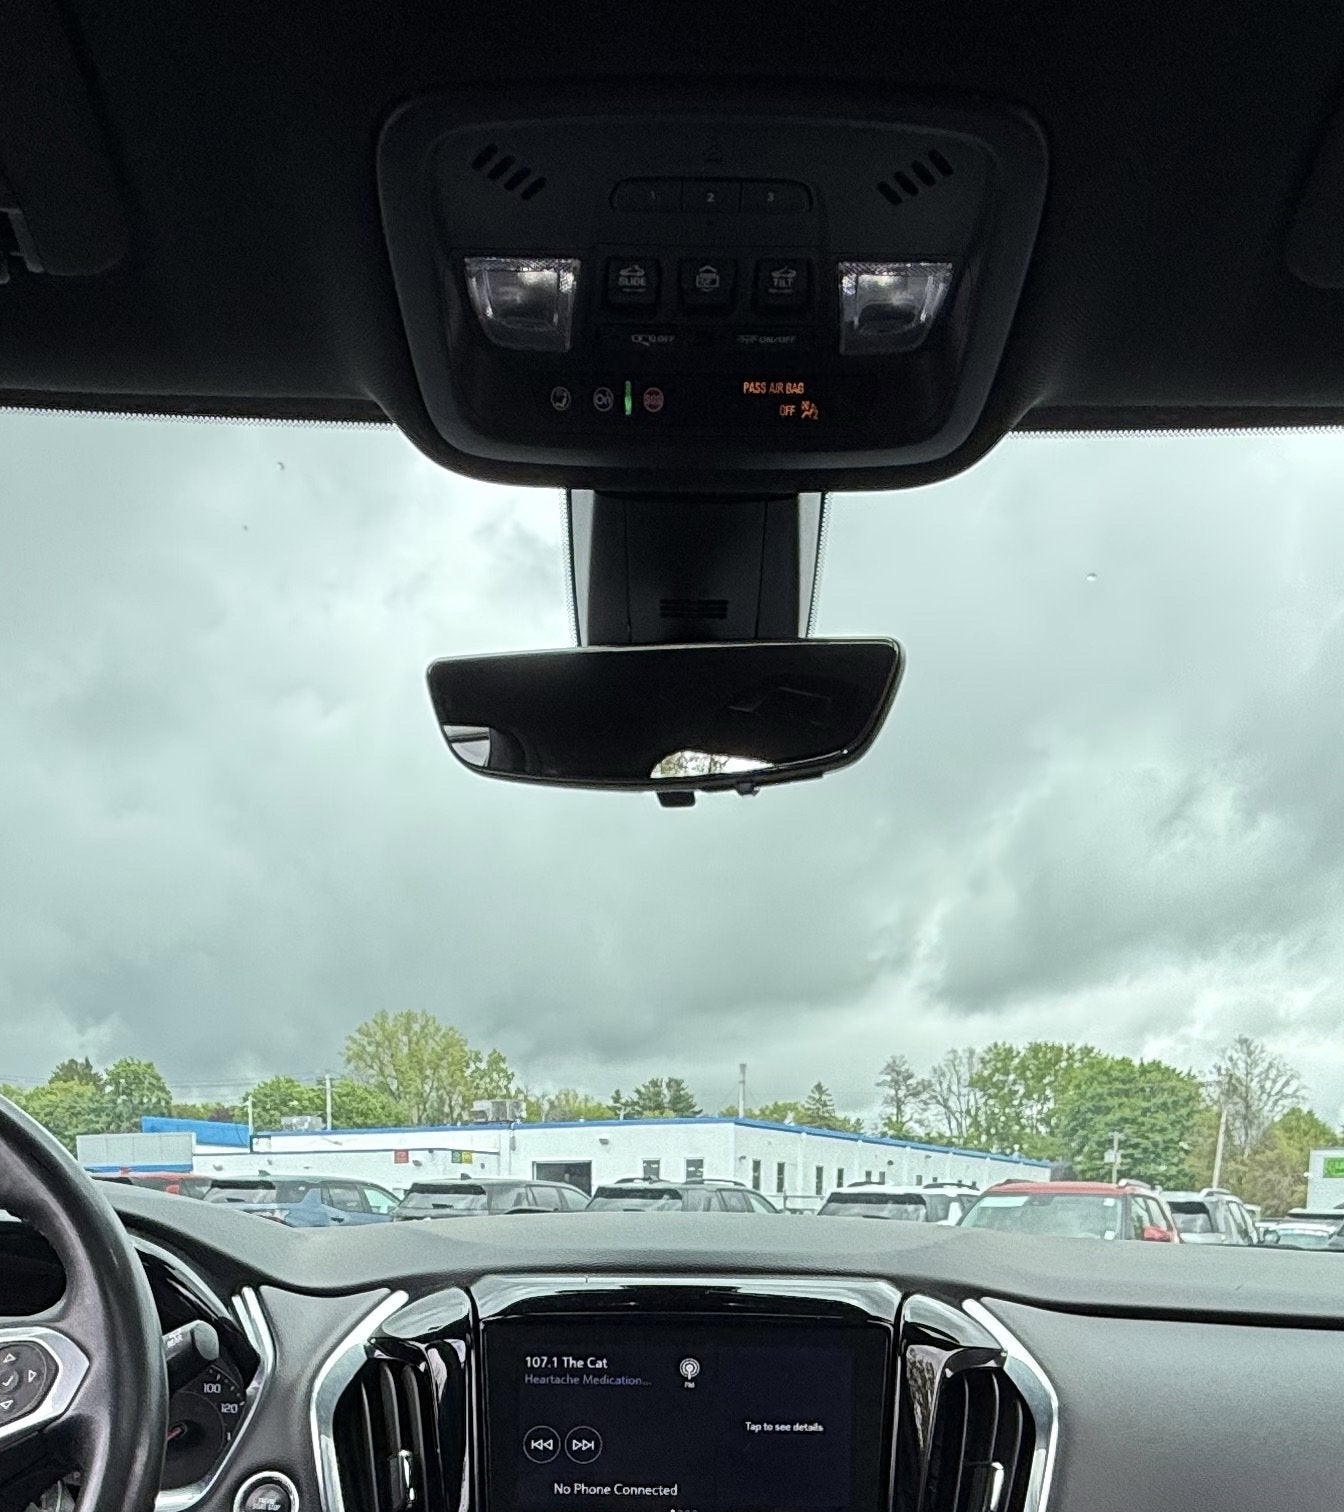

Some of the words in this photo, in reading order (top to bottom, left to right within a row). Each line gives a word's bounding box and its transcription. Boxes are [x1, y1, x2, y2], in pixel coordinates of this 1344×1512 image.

[743, 381, 767, 395] PASS
[769, 381, 784, 394] AIR
[785, 381, 805, 395] BAG
[779, 404, 796, 417] OFF
[525, 1355, 558, 1369] 107.1
[562, 1355, 584, 1369] The
[587, 1356, 608, 1370] Cat
[524, 1372, 580, 1385] Heartache
[203, 1382, 222, 1394] 100
[221, 1402, 238, 1414] 120
[745, 1421, 762, 1433] Tap
[774, 1424, 791, 1432] see
[792, 1422, 824, 1432] details
[553, 1482, 571, 1495] No
[573, 1482, 612, 1495] Phone
[613, 1483, 678, 1497] Connected
